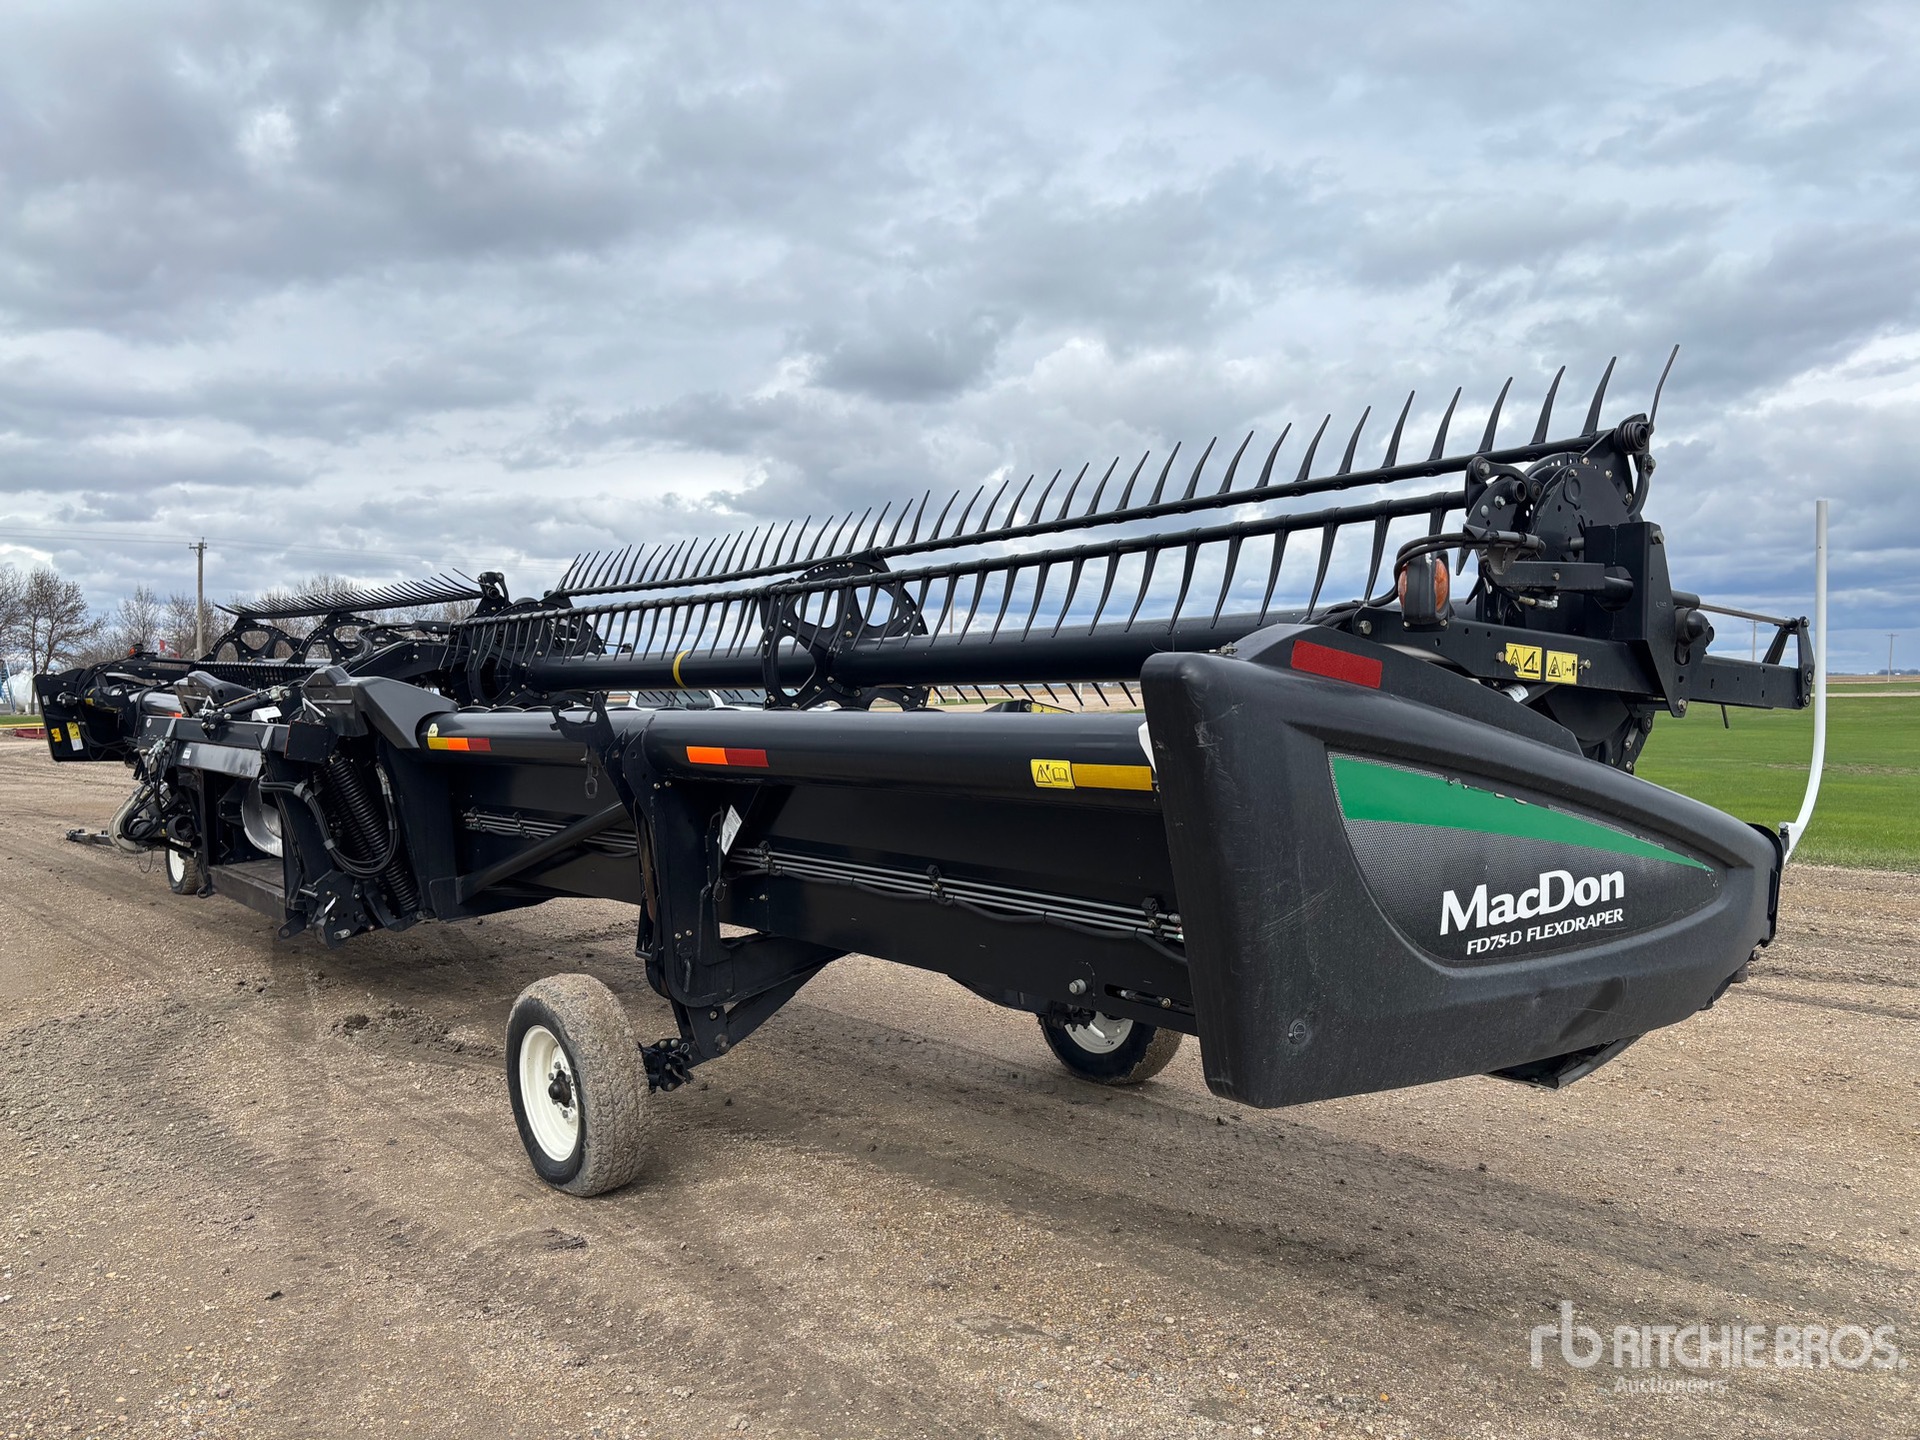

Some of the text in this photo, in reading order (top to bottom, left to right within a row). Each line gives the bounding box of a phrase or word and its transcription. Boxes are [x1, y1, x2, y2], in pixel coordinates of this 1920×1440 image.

[1440, 870, 1625, 935] MacDon
[1466, 908, 1624, 955] FD75-D FLEXDRAPER
